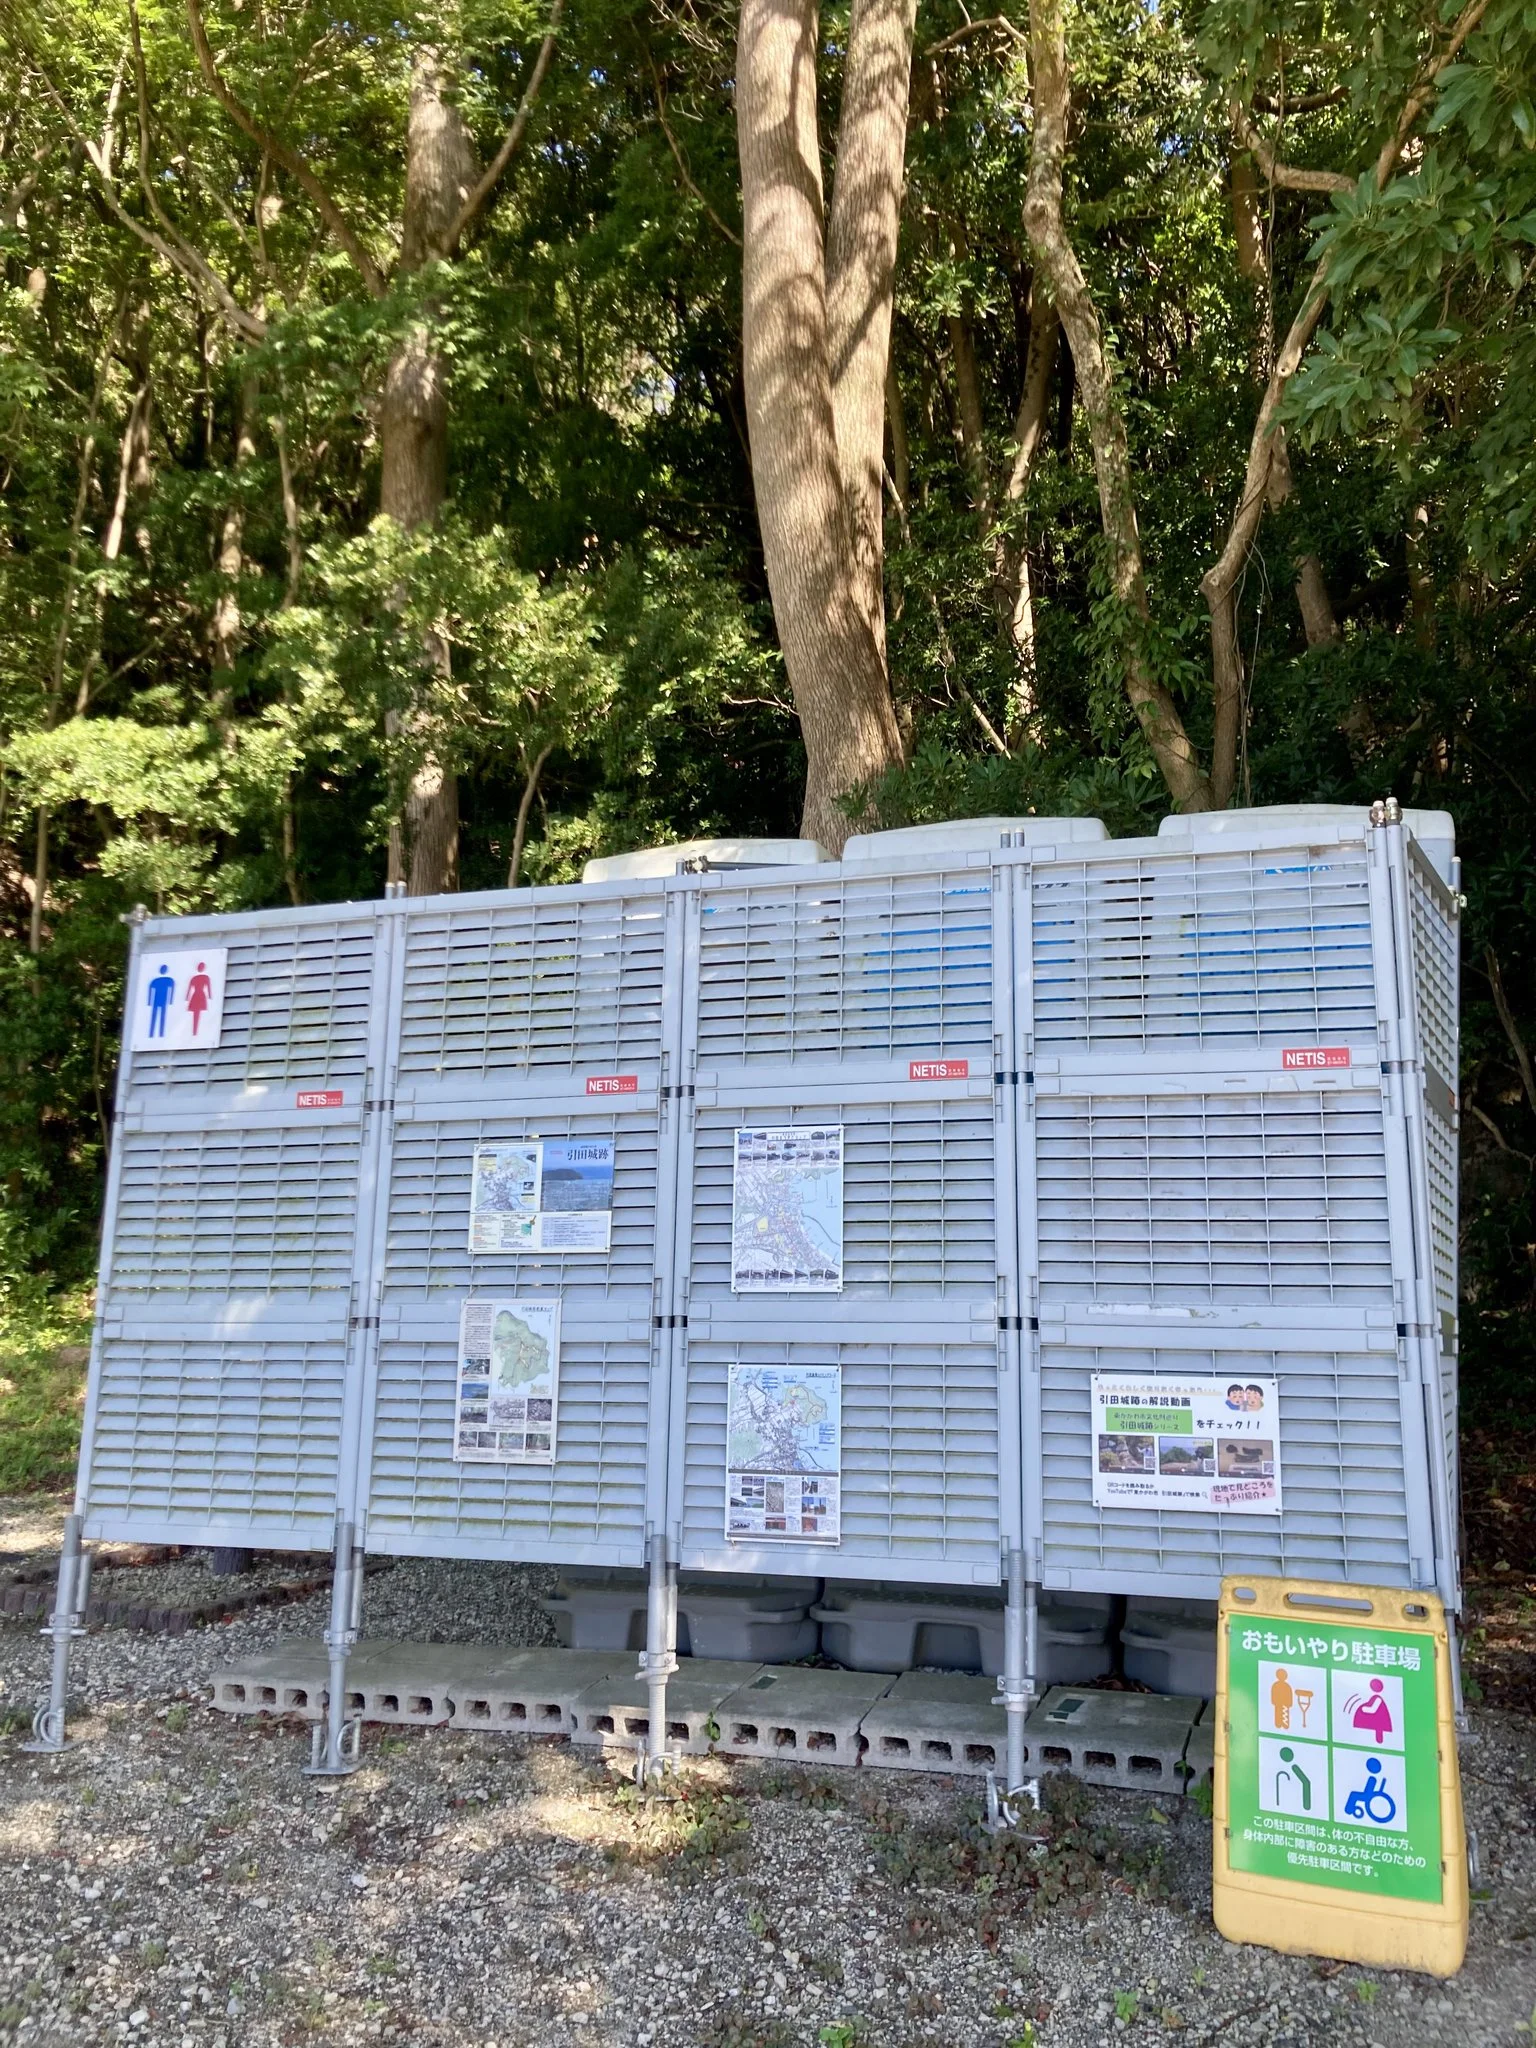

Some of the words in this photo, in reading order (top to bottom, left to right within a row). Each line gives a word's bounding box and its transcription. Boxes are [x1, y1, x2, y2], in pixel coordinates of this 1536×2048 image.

[1286, 1052, 1326, 1065] NETIS
[912, 1064, 947, 1076] NETIS
[589, 1080, 620, 1091] NETIS
[298, 1094, 327, 1106] NETIS
[567, 1148, 609, 1160] 引田城跡
[1099, 1394, 1191, 1407] 引田城跡の解説動画
[1242, 1629, 1421, 1671] おもいやり駐車場
[1287, 1851, 1379, 1877] 優先駐車区間です。
